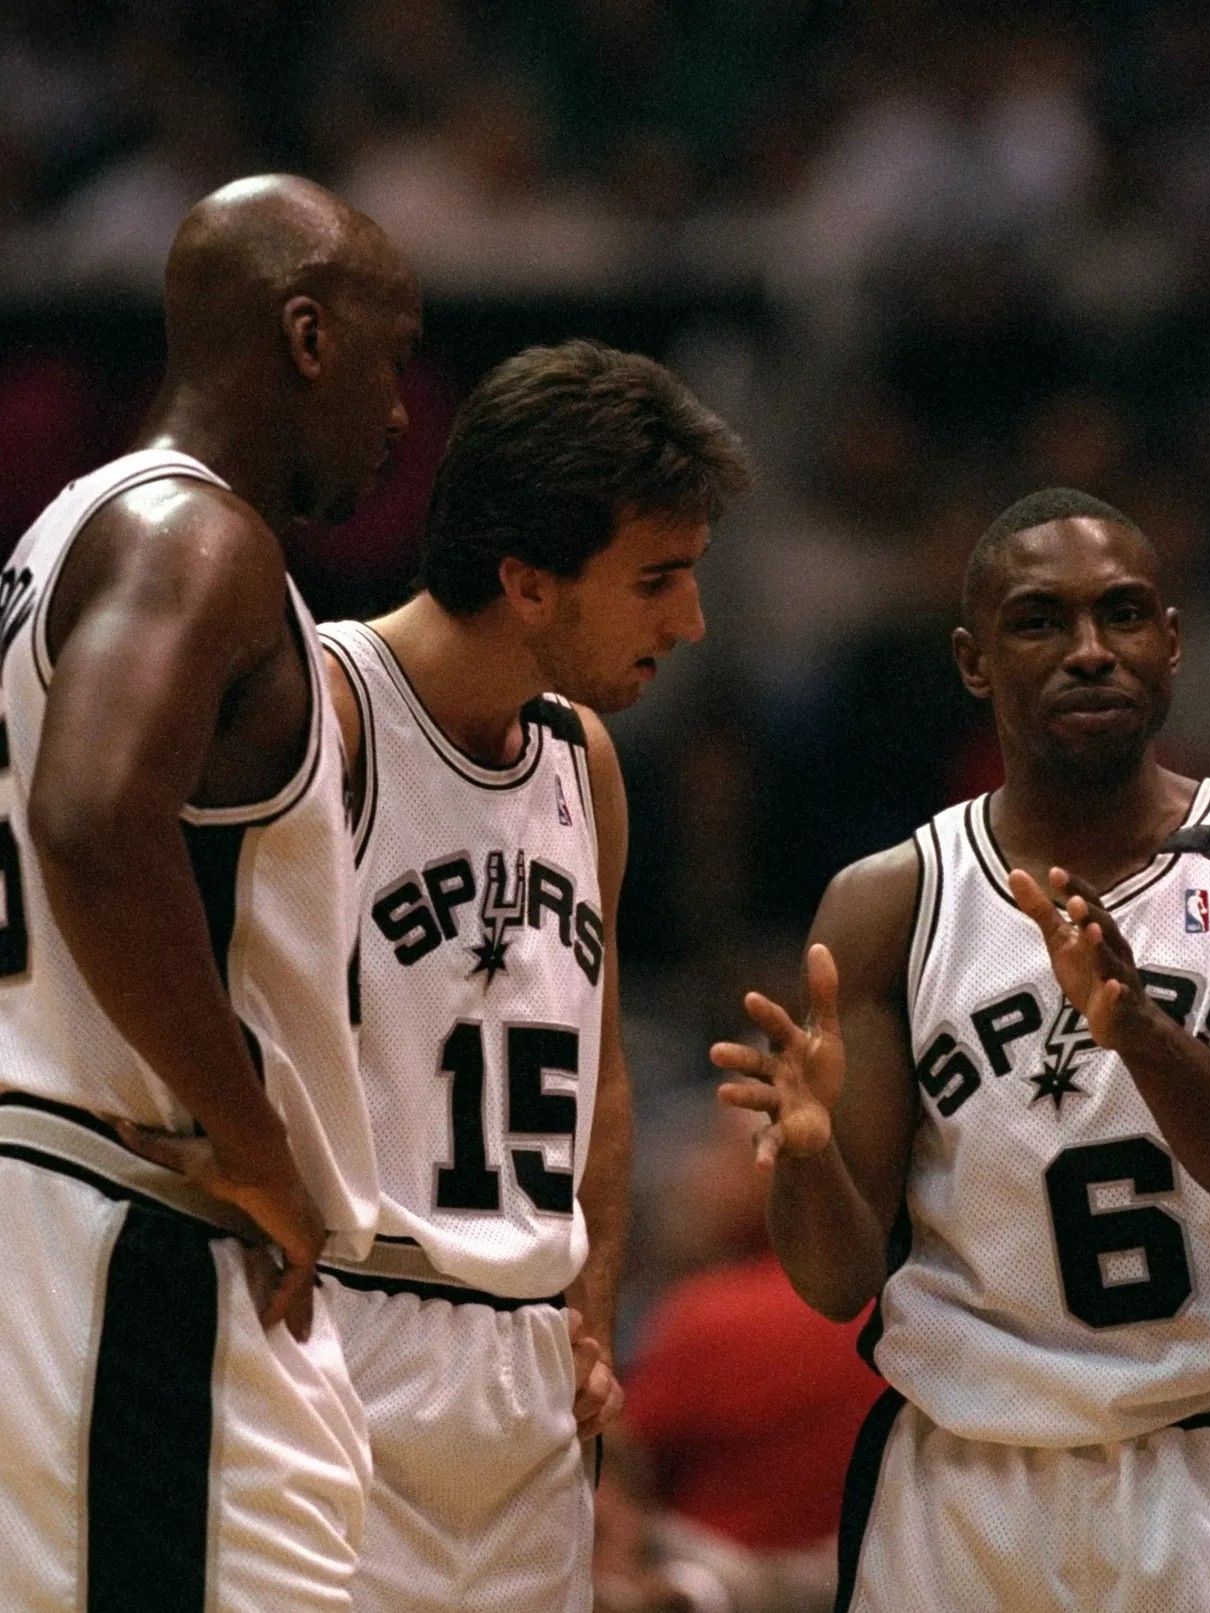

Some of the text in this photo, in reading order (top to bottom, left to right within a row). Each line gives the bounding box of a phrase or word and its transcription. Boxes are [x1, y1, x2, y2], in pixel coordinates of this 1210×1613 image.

[371, 848, 605, 995] SPURS
[431, 1017, 580, 1220] 15
[1044, 1131, 1200, 1333] 6
